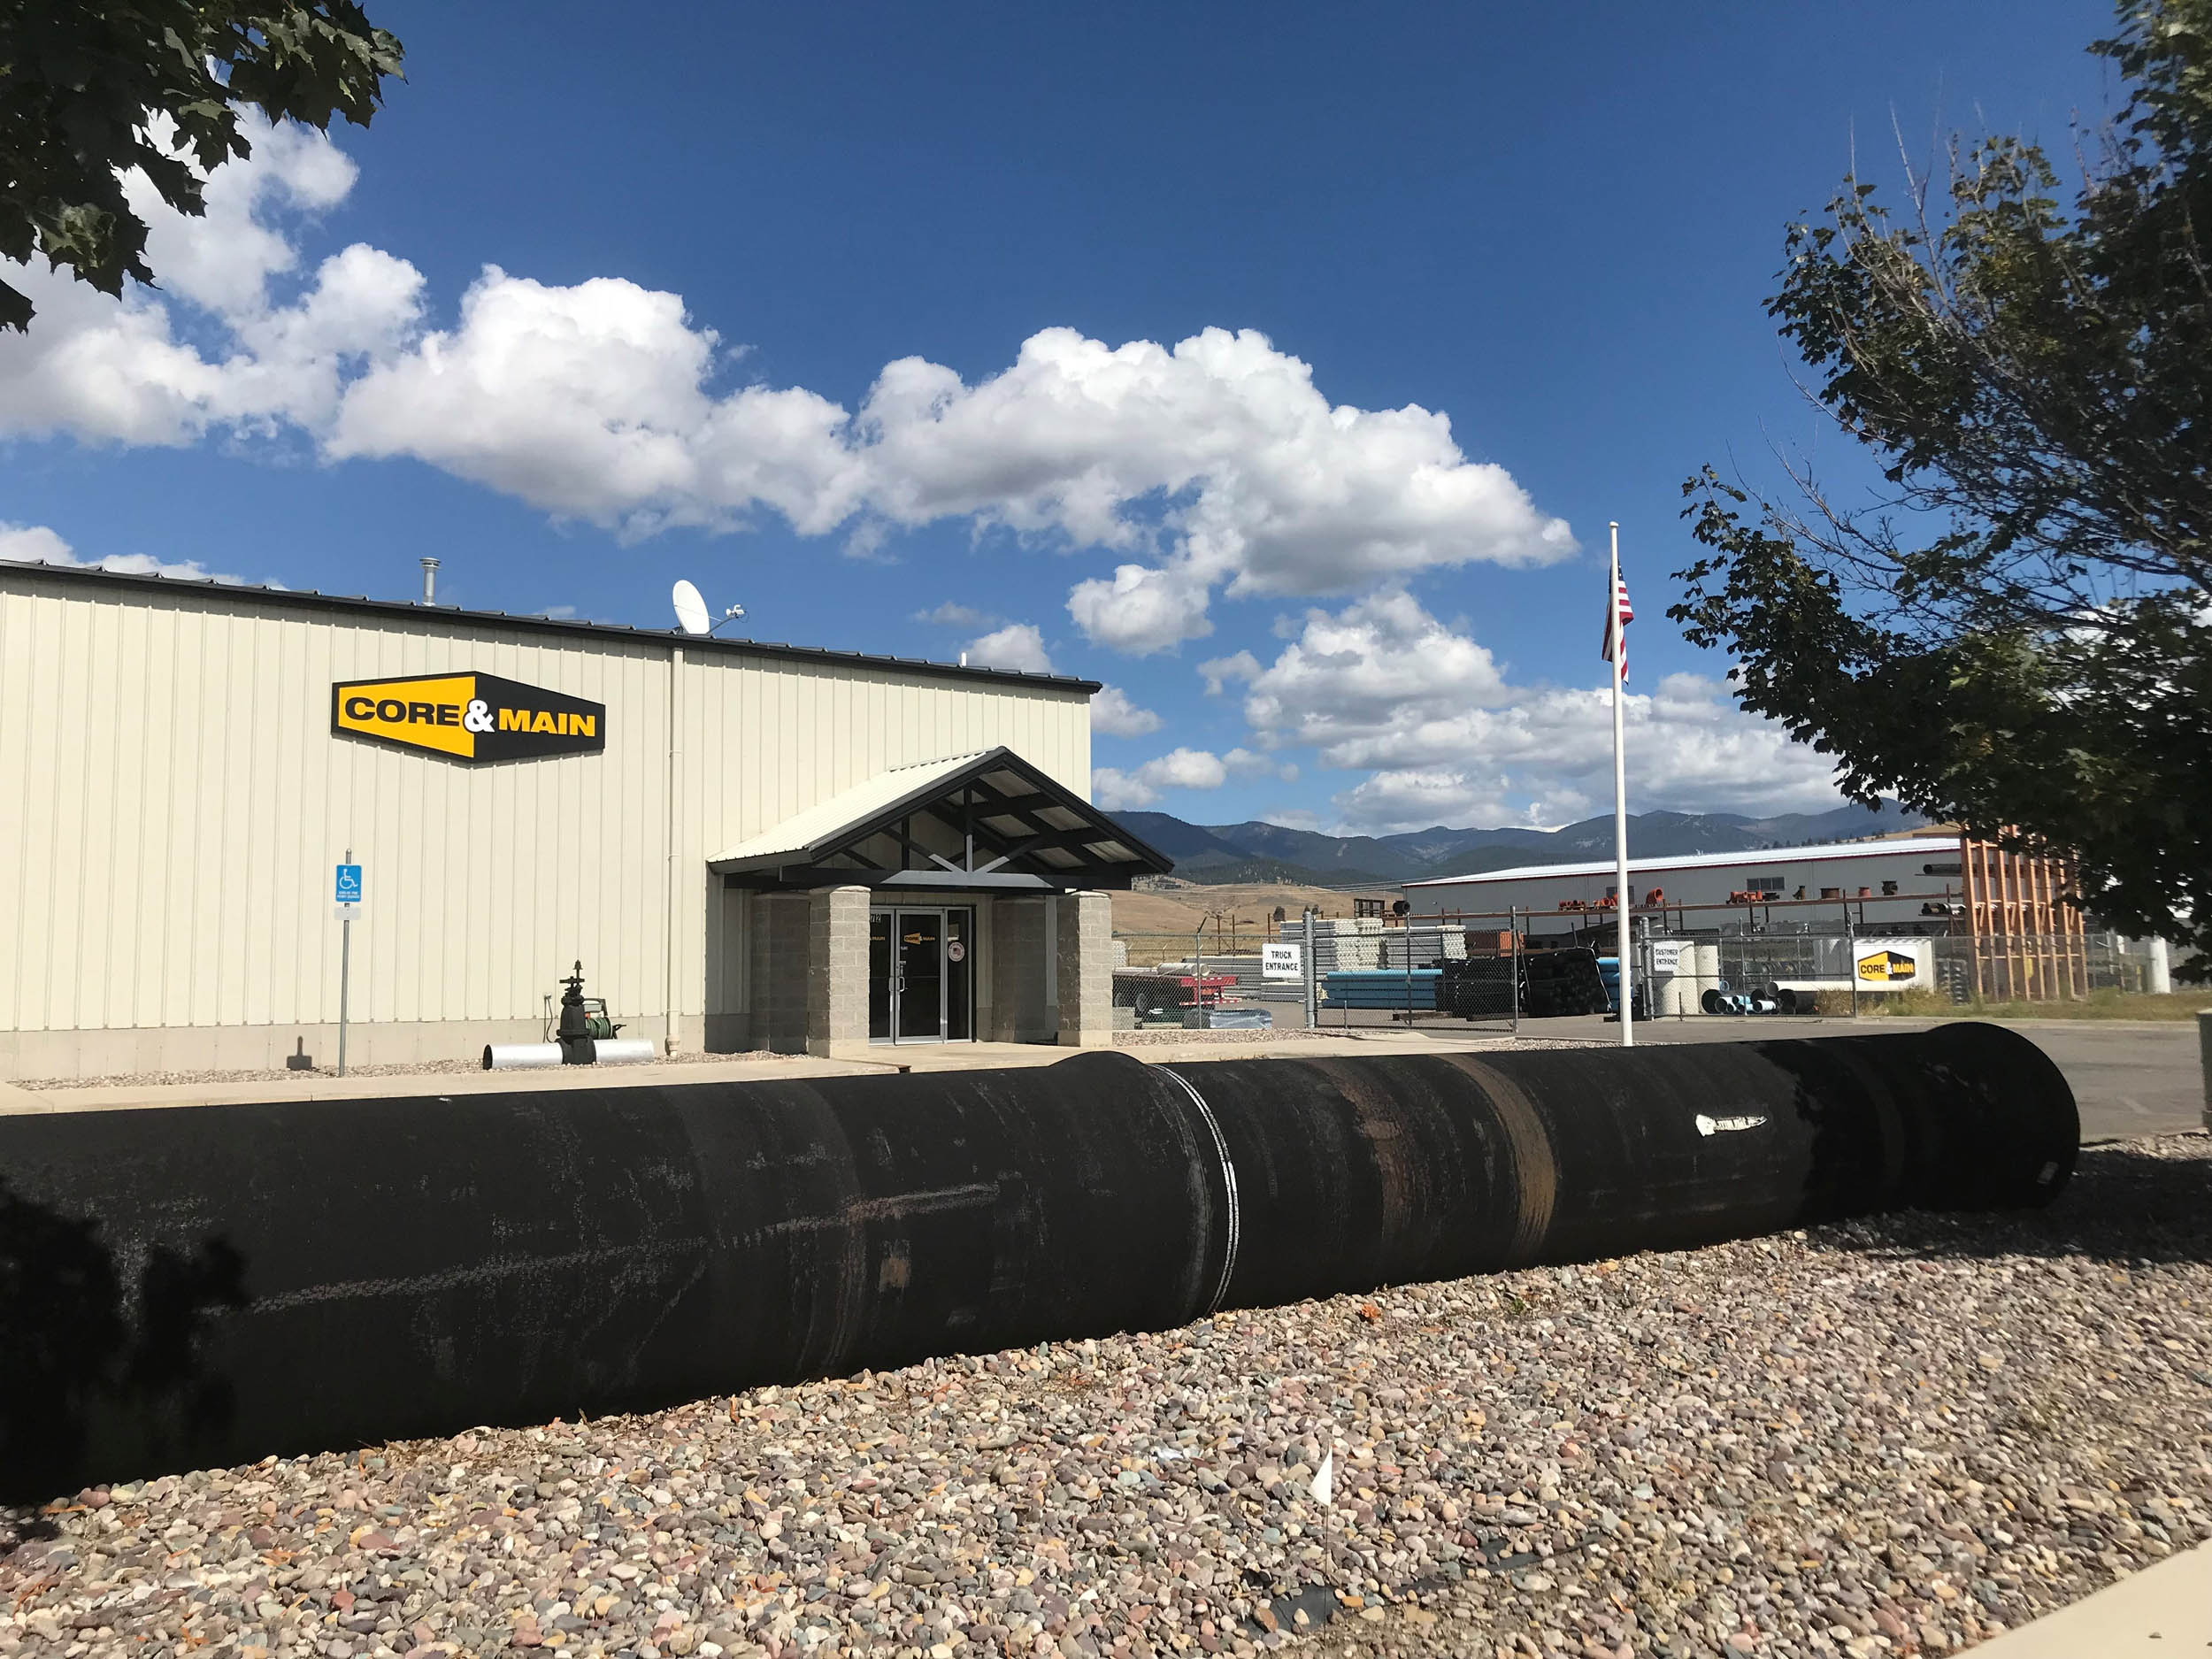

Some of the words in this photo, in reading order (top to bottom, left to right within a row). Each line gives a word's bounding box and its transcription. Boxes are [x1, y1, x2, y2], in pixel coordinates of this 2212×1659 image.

[345, 696, 460, 726] CORE
[464, 699, 495, 733] &
[498, 708, 595, 737] MAIN
[1271, 950, 1292, 959] TRUCK
[1860, 964, 1885, 974] CORE
[1886, 961, 1893, 975] &
[1893, 963, 1914, 973] MAIN
